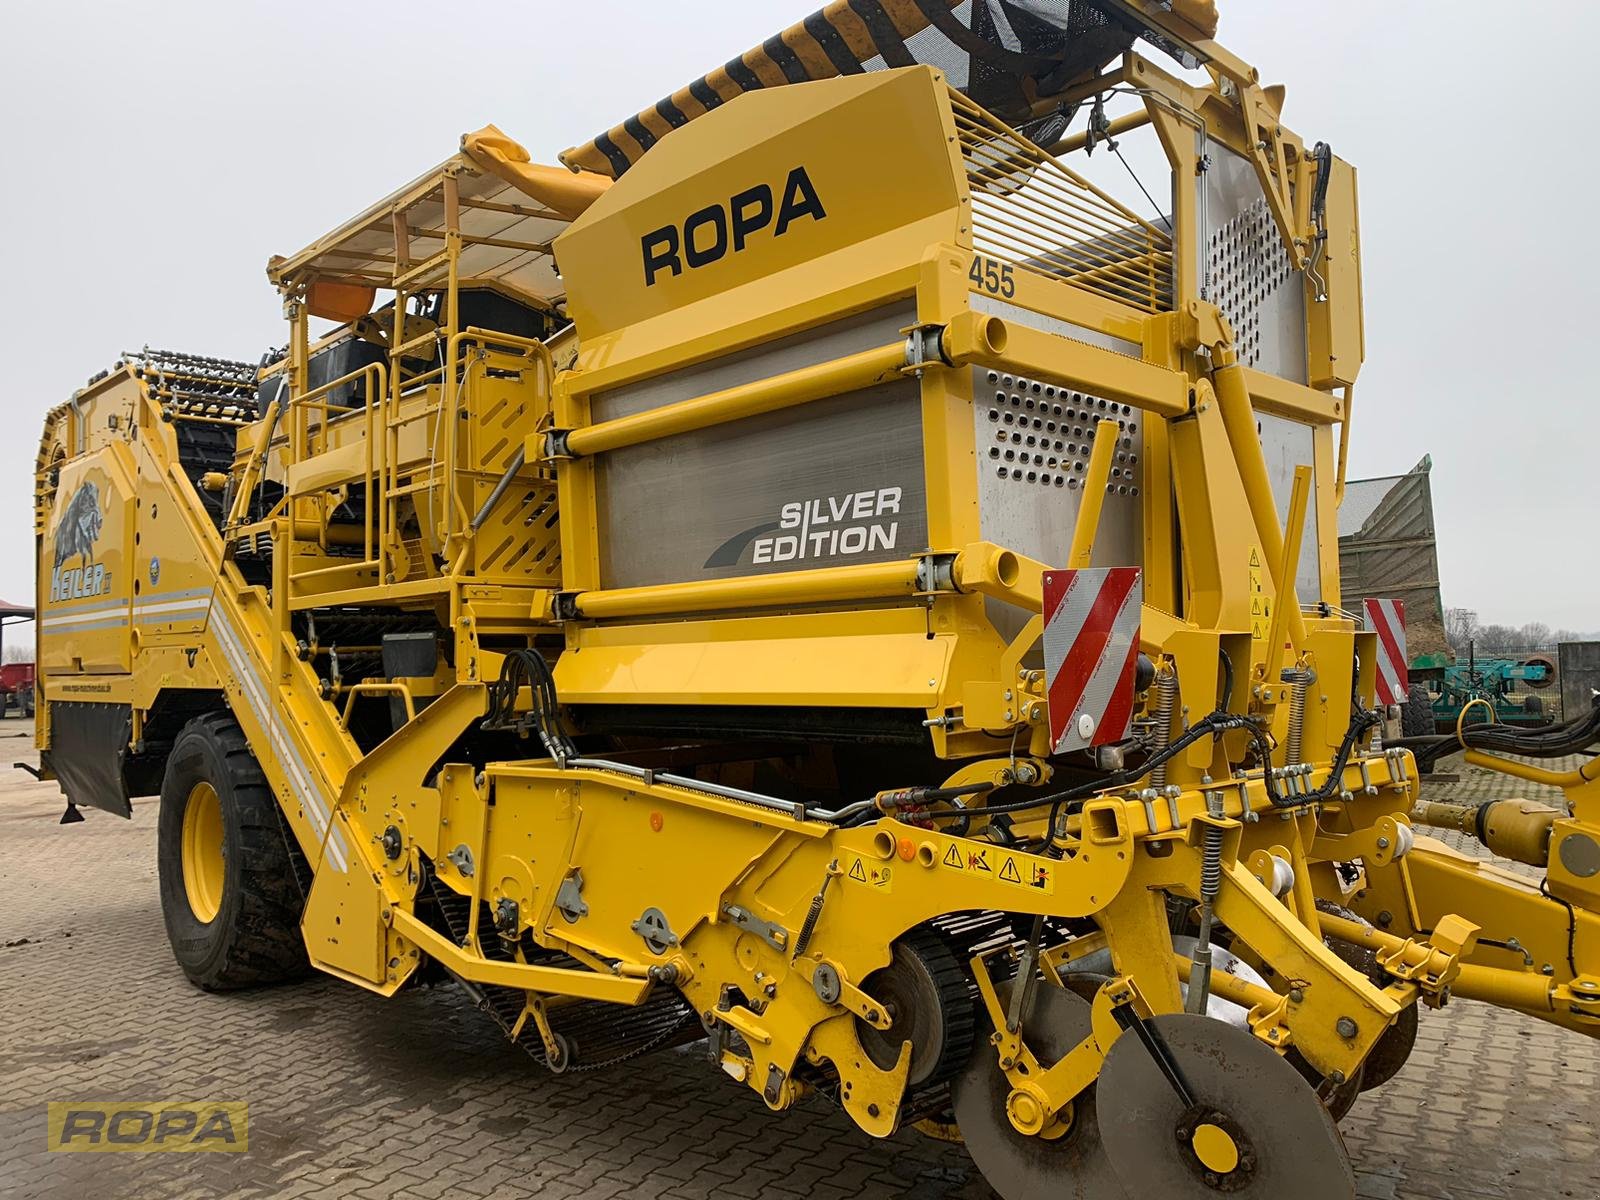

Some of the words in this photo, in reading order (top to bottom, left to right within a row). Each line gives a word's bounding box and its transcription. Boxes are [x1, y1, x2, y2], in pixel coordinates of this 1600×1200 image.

[641, 166, 827, 287] ROPA
[969, 255, 1015, 298] 455
[780, 486, 903, 530] SILVER
[752, 521, 899, 565] EDITION
[49, 562, 104, 603] KEILER
